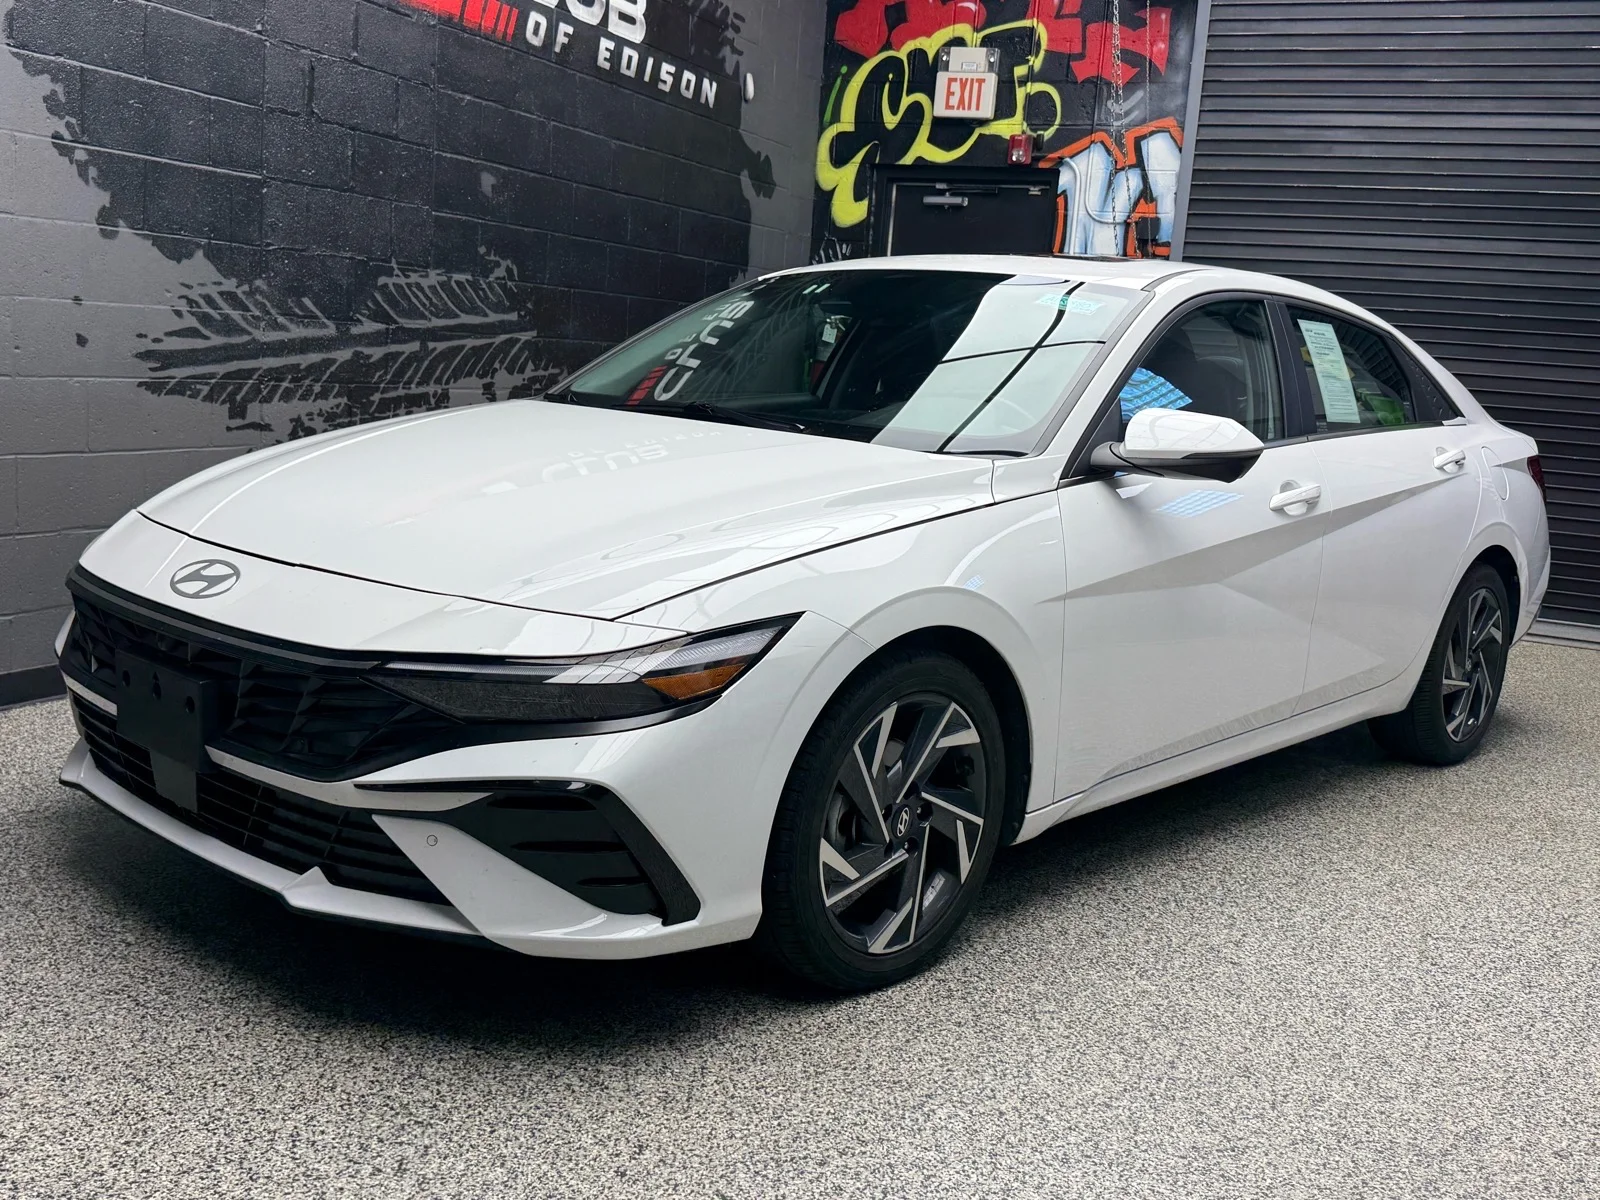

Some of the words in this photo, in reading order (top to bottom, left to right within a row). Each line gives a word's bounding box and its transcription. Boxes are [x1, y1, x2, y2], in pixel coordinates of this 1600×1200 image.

[526, 11, 574, 54] OF
[596, 36, 718, 109] EDISON
[945, 77, 986, 111] EXIT
